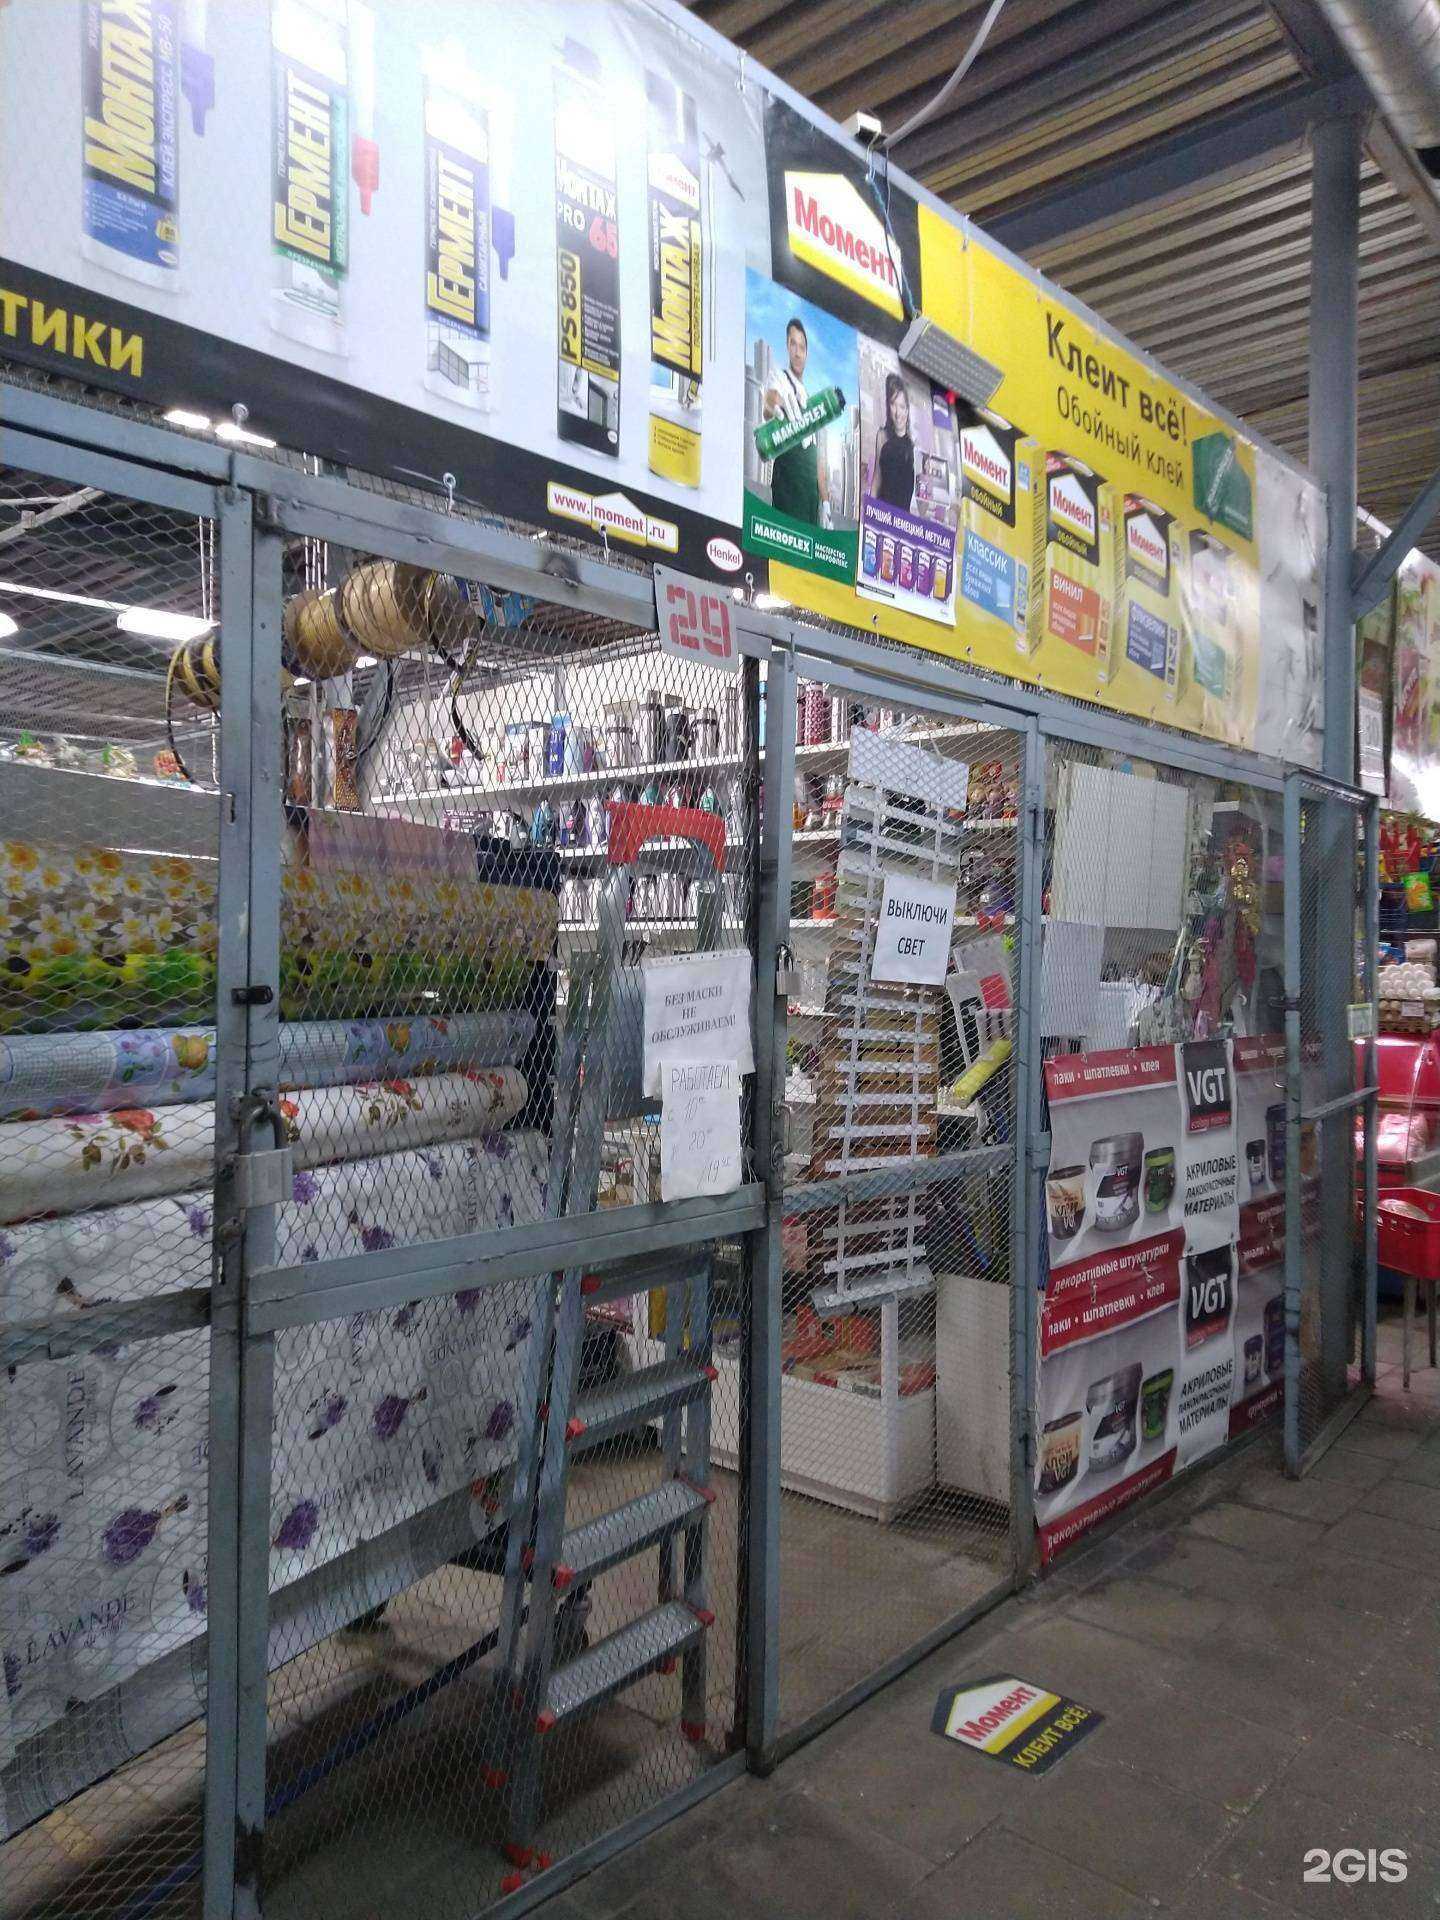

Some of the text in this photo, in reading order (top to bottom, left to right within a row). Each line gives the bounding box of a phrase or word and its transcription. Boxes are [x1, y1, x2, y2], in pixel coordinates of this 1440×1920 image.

[794, 187, 901, 288] Момент
[560, 250, 578, 312] 850
[1046, 312, 1187, 446] Клеит всё!
[1057, 385, 1142, 465] Обойный
[1147, 449, 1184, 490] клей
[963, 437, 1008, 488] Момент
[553, 490, 666, 541] www.moment.ru
[1053, 487, 1092, 529] Момент
[709, 544, 742, 567] Henkel
[754, 522, 811, 554] MAKROFLEX
[666, 584, 732, 658] 29
[887, 899, 947, 926] ВЫКЛЮЧИ
[897, 936, 926, 957] СВЕТ
[681, 1005, 698, 1020] НЕ
[686, 984, 724, 1004] МАСКИ
[1053, 1061, 1160, 1085] лаки шпатлевки клея
[1187, 1067, 1226, 1106] VGT
[1186, 1155, 1236, 1181] АКРИЛОВЫЕ
[1184, 1190, 1236, 1218] МАТЕРИАЛЫ
[1053, 1243, 1169, 1294] декоративные штукатурки
[1048, 1282, 1165, 1337] лаки шпатлевки клея
[1191, 1273, 1229, 1319] VGT
[1181, 1359, 1233, 1396] АКРИЛОВЫЕ
[956, 1686, 1038, 1742] Момент
[1012, 1726, 1064, 1769] КЛЕИТ
